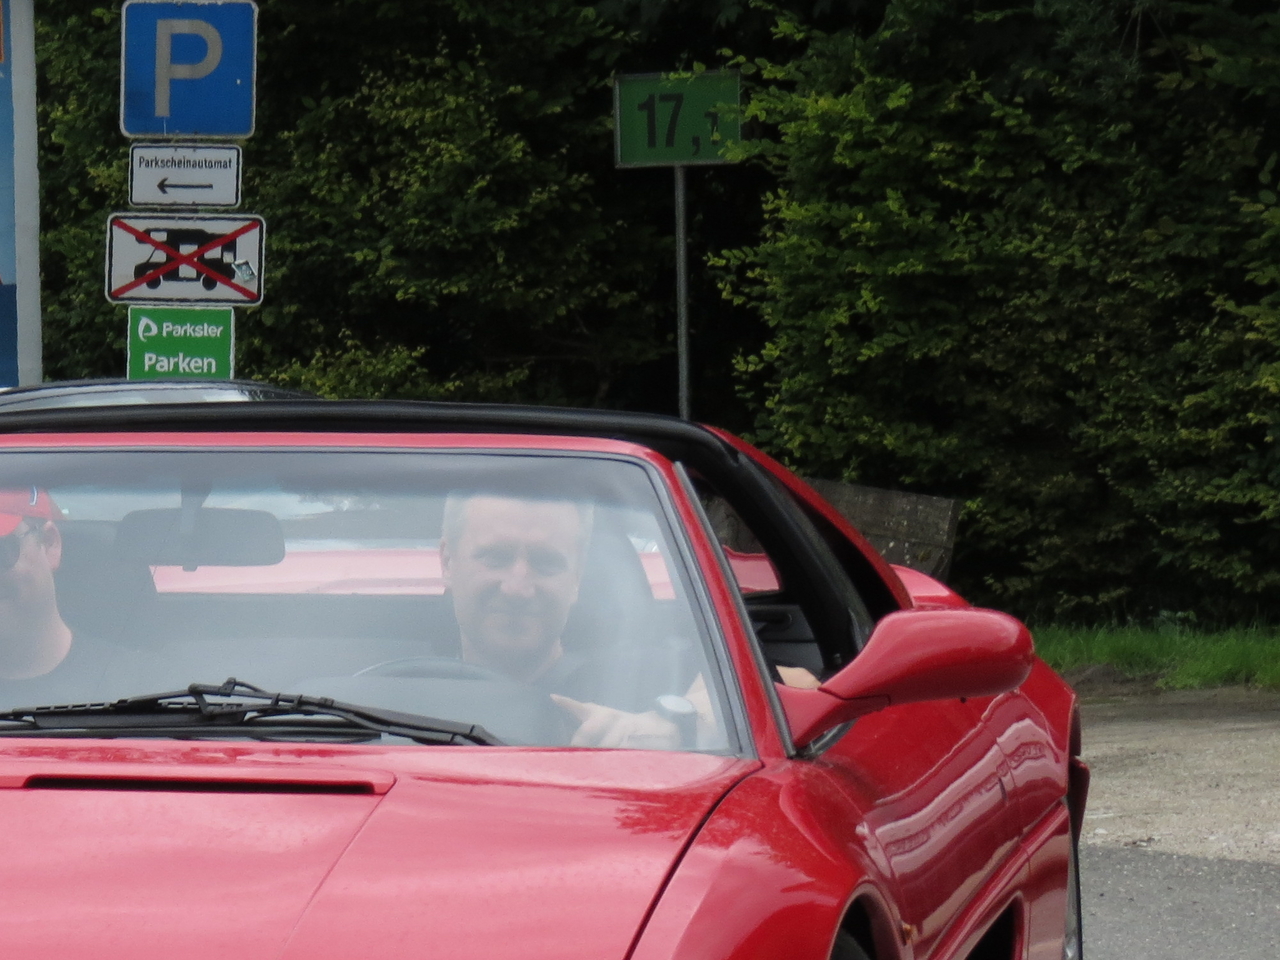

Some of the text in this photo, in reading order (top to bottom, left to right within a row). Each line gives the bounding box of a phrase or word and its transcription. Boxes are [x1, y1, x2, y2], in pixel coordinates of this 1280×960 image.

[155, 19, 223, 117] P
[138, 155, 233, 170] Parkscheinautomat
[162, 322, 224, 338] Parkster
[144, 352, 217, 374] Parken
